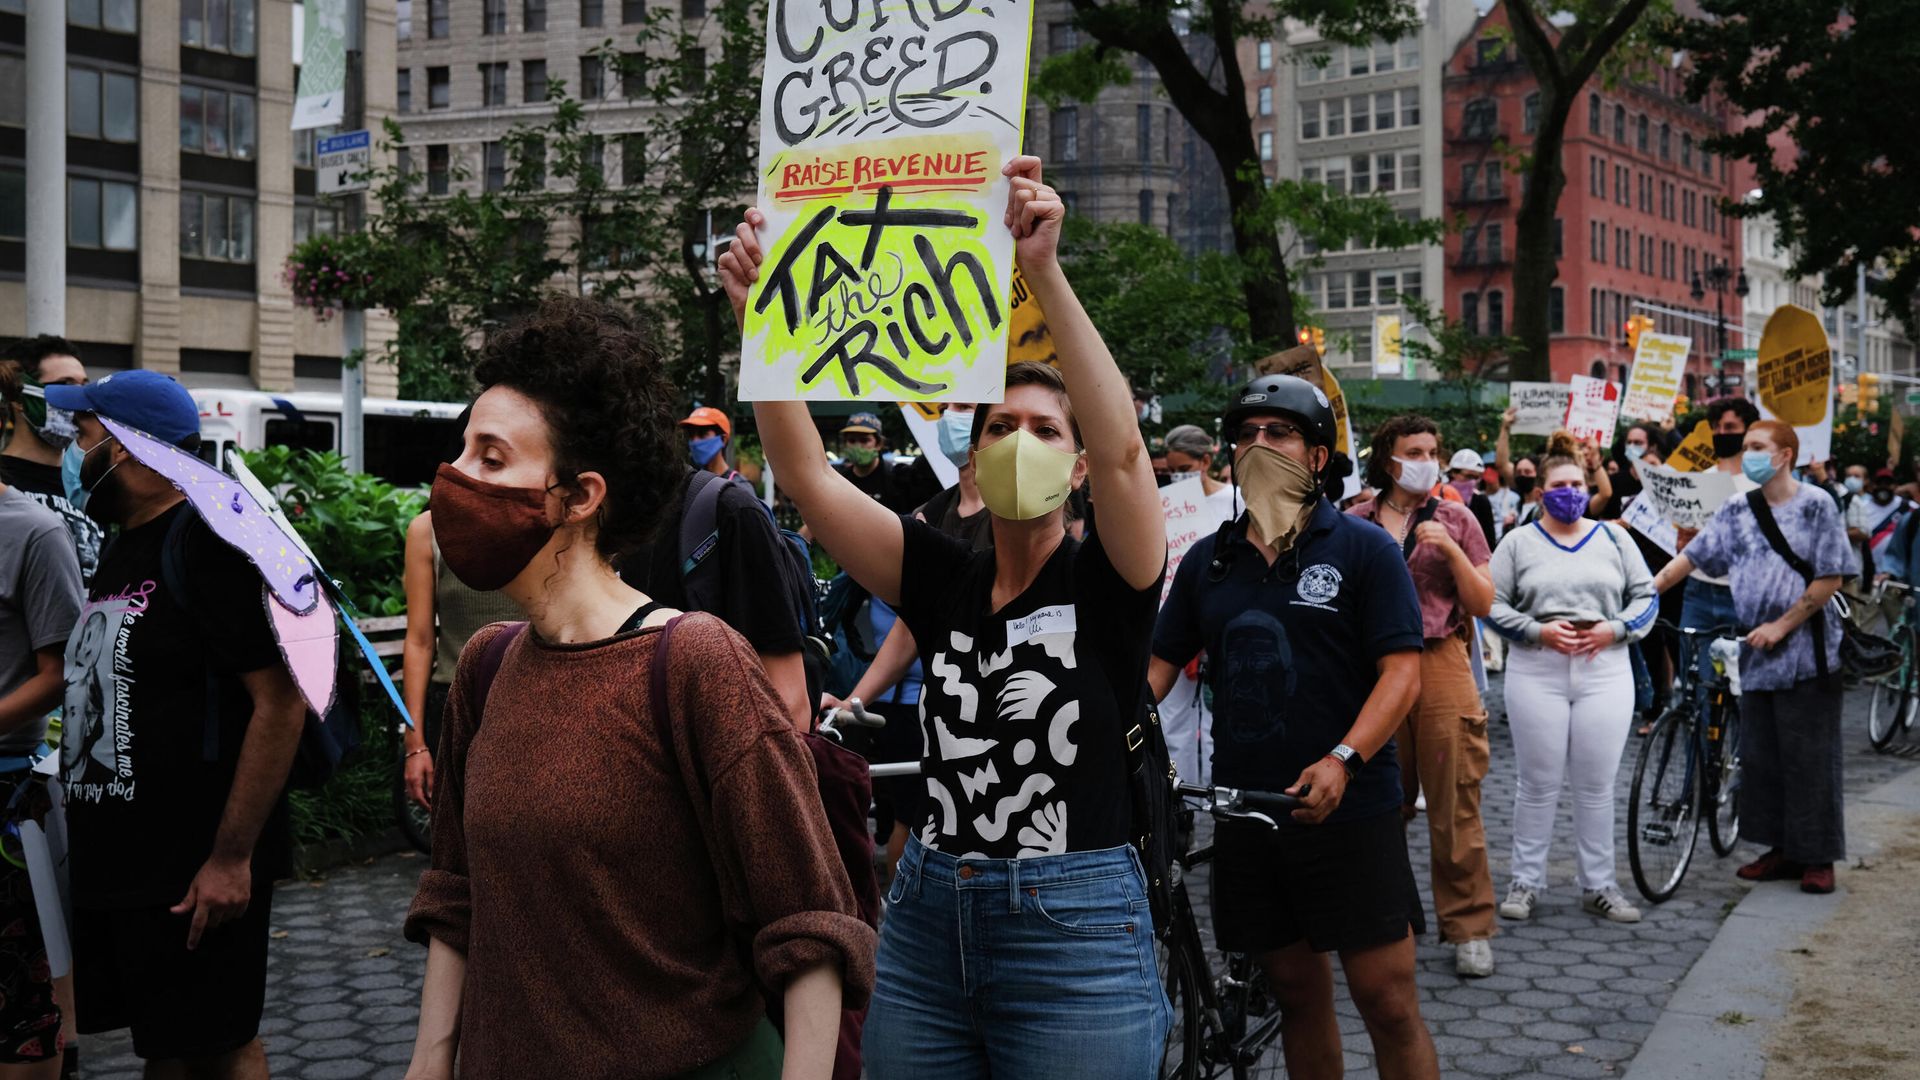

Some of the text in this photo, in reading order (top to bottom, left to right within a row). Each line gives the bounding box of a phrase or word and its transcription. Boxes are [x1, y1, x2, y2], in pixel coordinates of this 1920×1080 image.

[321, 151, 366, 169] BUSES ONLY
[853, 151, 988, 185] REVENUE
[754, 186, 978, 336] TAX
[814, 251, 903, 346] the
[114, 627, 135, 673] world
[107, 673, 136, 753] fascinates
[117, 754, 133, 778] me
